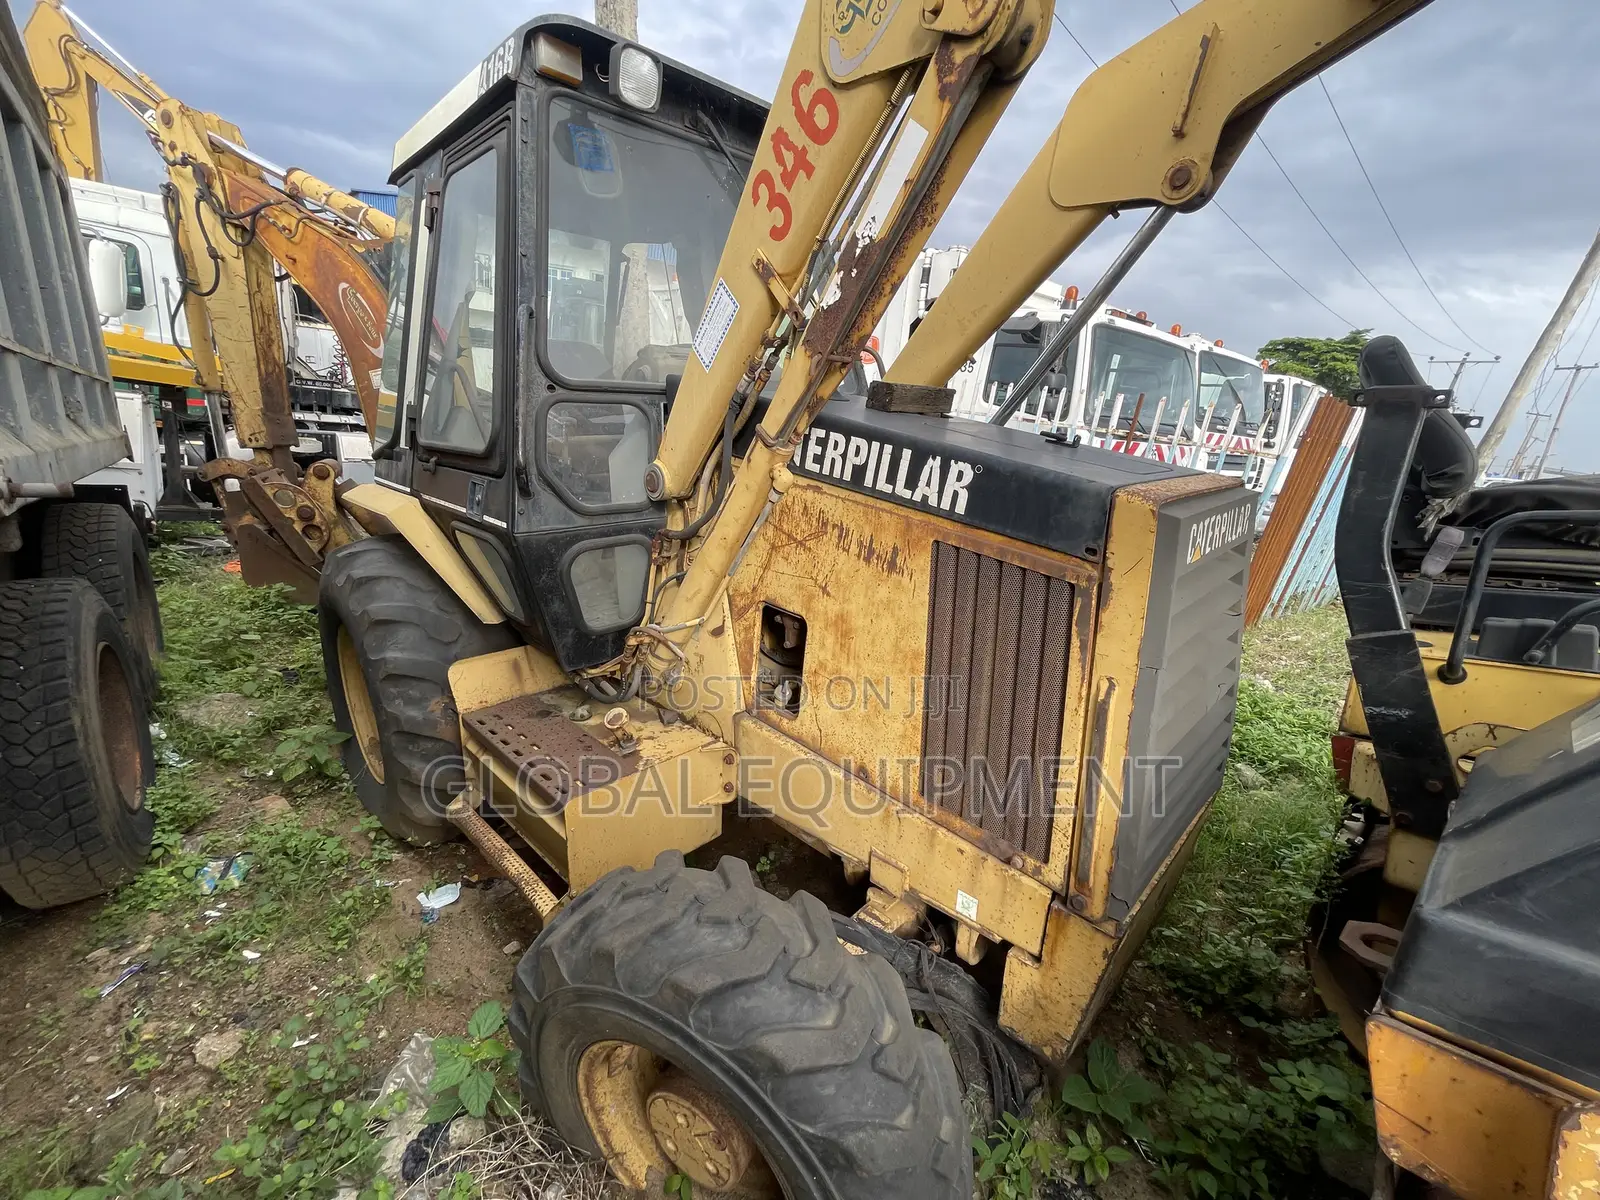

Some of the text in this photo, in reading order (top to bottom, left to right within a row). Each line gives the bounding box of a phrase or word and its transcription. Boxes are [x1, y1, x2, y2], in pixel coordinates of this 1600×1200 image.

[478, 37, 515, 97] 416B
[752, 69, 839, 241] 346
[793, 427, 974, 515] TERPILLAR
[1187, 503, 1251, 565] CATERPILLAR
